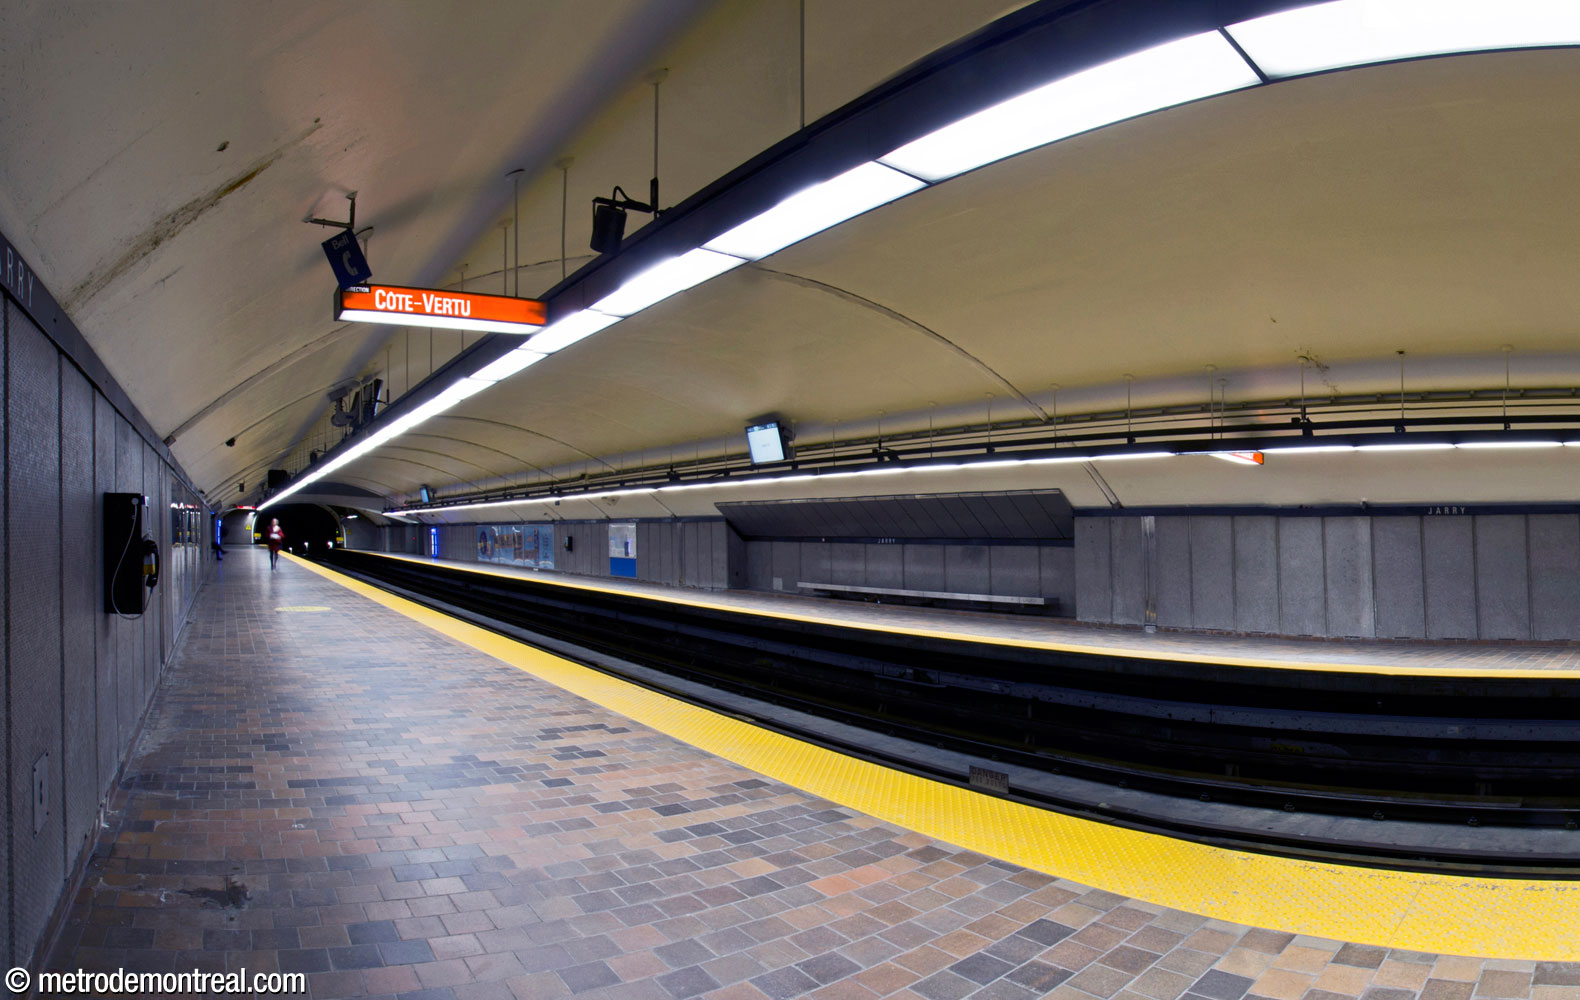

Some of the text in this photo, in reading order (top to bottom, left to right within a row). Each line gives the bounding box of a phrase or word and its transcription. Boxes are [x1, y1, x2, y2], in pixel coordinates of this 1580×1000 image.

[332, 234, 350, 250] Bell
[0, 246, 34, 308] RRY
[1428, 506, 1465, 515] JARRY
[971, 767, 1006, 783] DANGER
